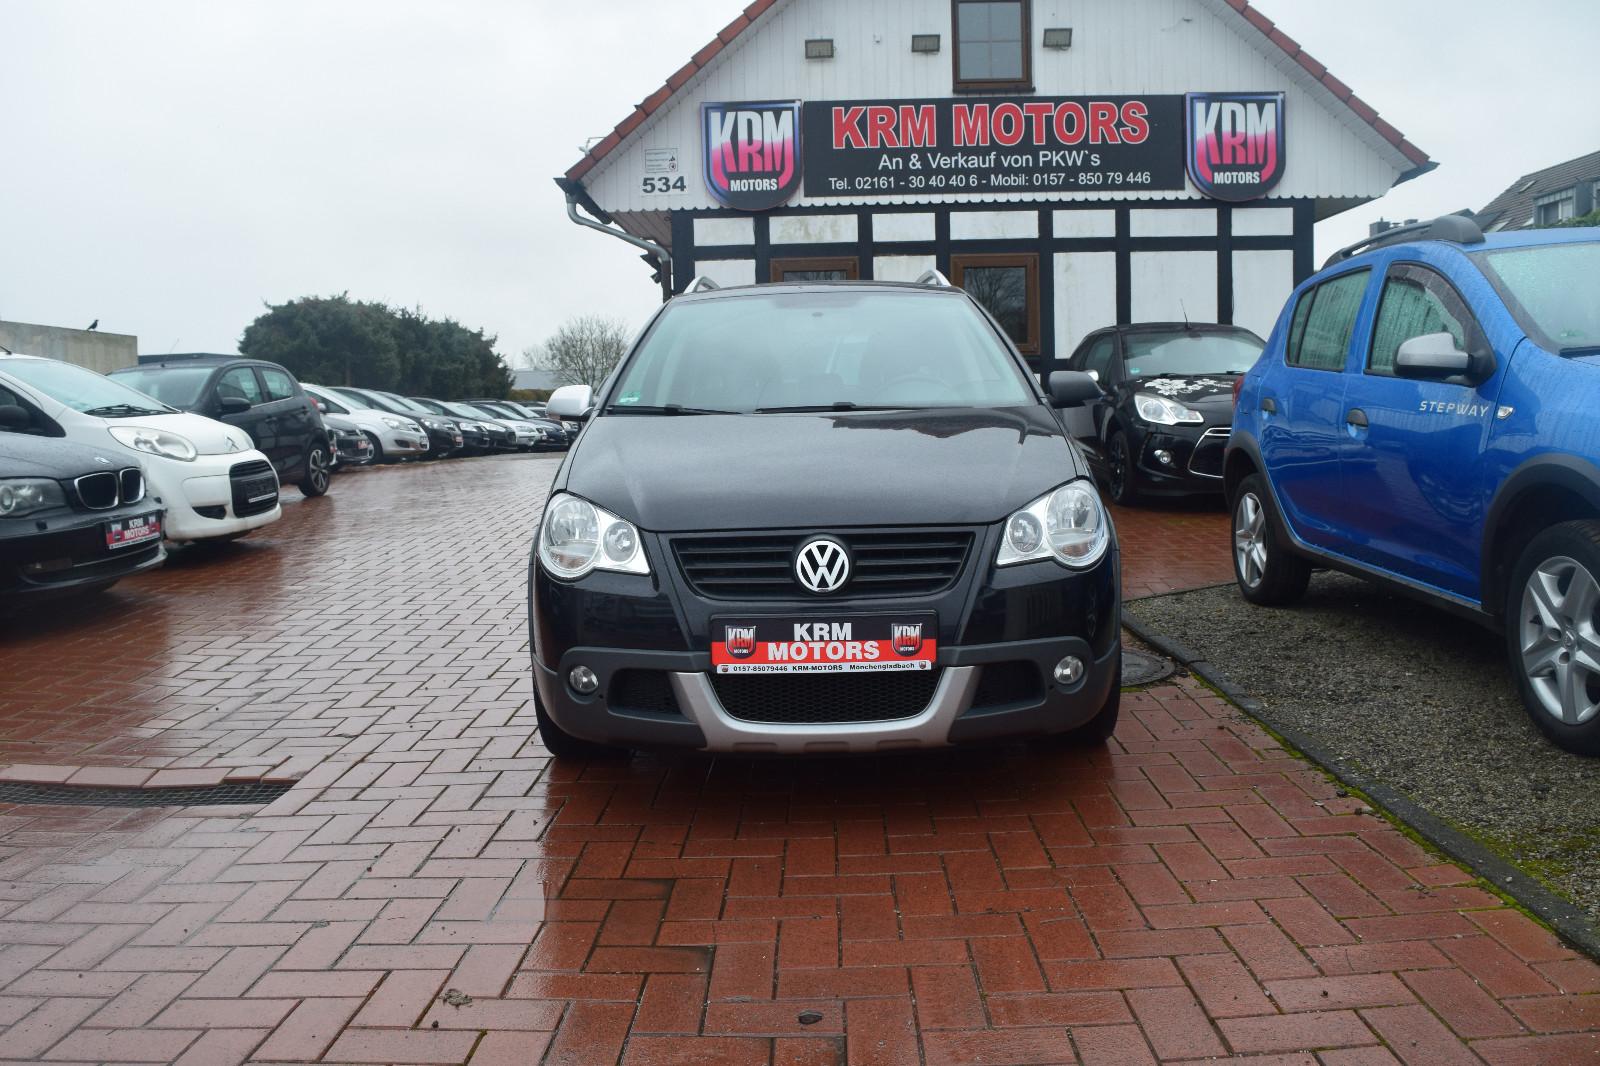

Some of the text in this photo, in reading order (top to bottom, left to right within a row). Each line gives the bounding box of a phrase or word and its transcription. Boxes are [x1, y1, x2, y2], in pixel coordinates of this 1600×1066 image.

[832, 101, 1150, 149] KRM MOTORS
[711, 110, 794, 191] KRM
[1196, 102, 1277, 184] KRM
[878, 153, 903, 170] An
[908, 153, 922, 170] &
[927, 151, 997, 169] Verkauf
[1000, 154, 1033, 168] von
[642, 175, 687, 193] 534
[730, 178, 778, 192] MOTORS
[828, 177, 851, 190] Tel.
[855, 176, 895, 189] 02161
[908, 175, 925, 188] 30
[928, 174, 946, 188] 40
[948, 174, 966, 187] 40
[969, 174, 978, 187] 6
[990, 173, 1029, 186] Mobil:
[1033, 172, 1066, 186] 0157
[1078, 172, 1103, 185] 850
[1106, 171, 1123, 184] 79
[1126, 171, 1151, 184] 446
[1213, 171, 1260, 184] MOTORS
[1419, 400, 1488, 416] STEPWAY
[124, 525, 150, 540] MOTORS
[794, 622, 852, 642] KRM
[767, 640, 880, 661] MOTORS
